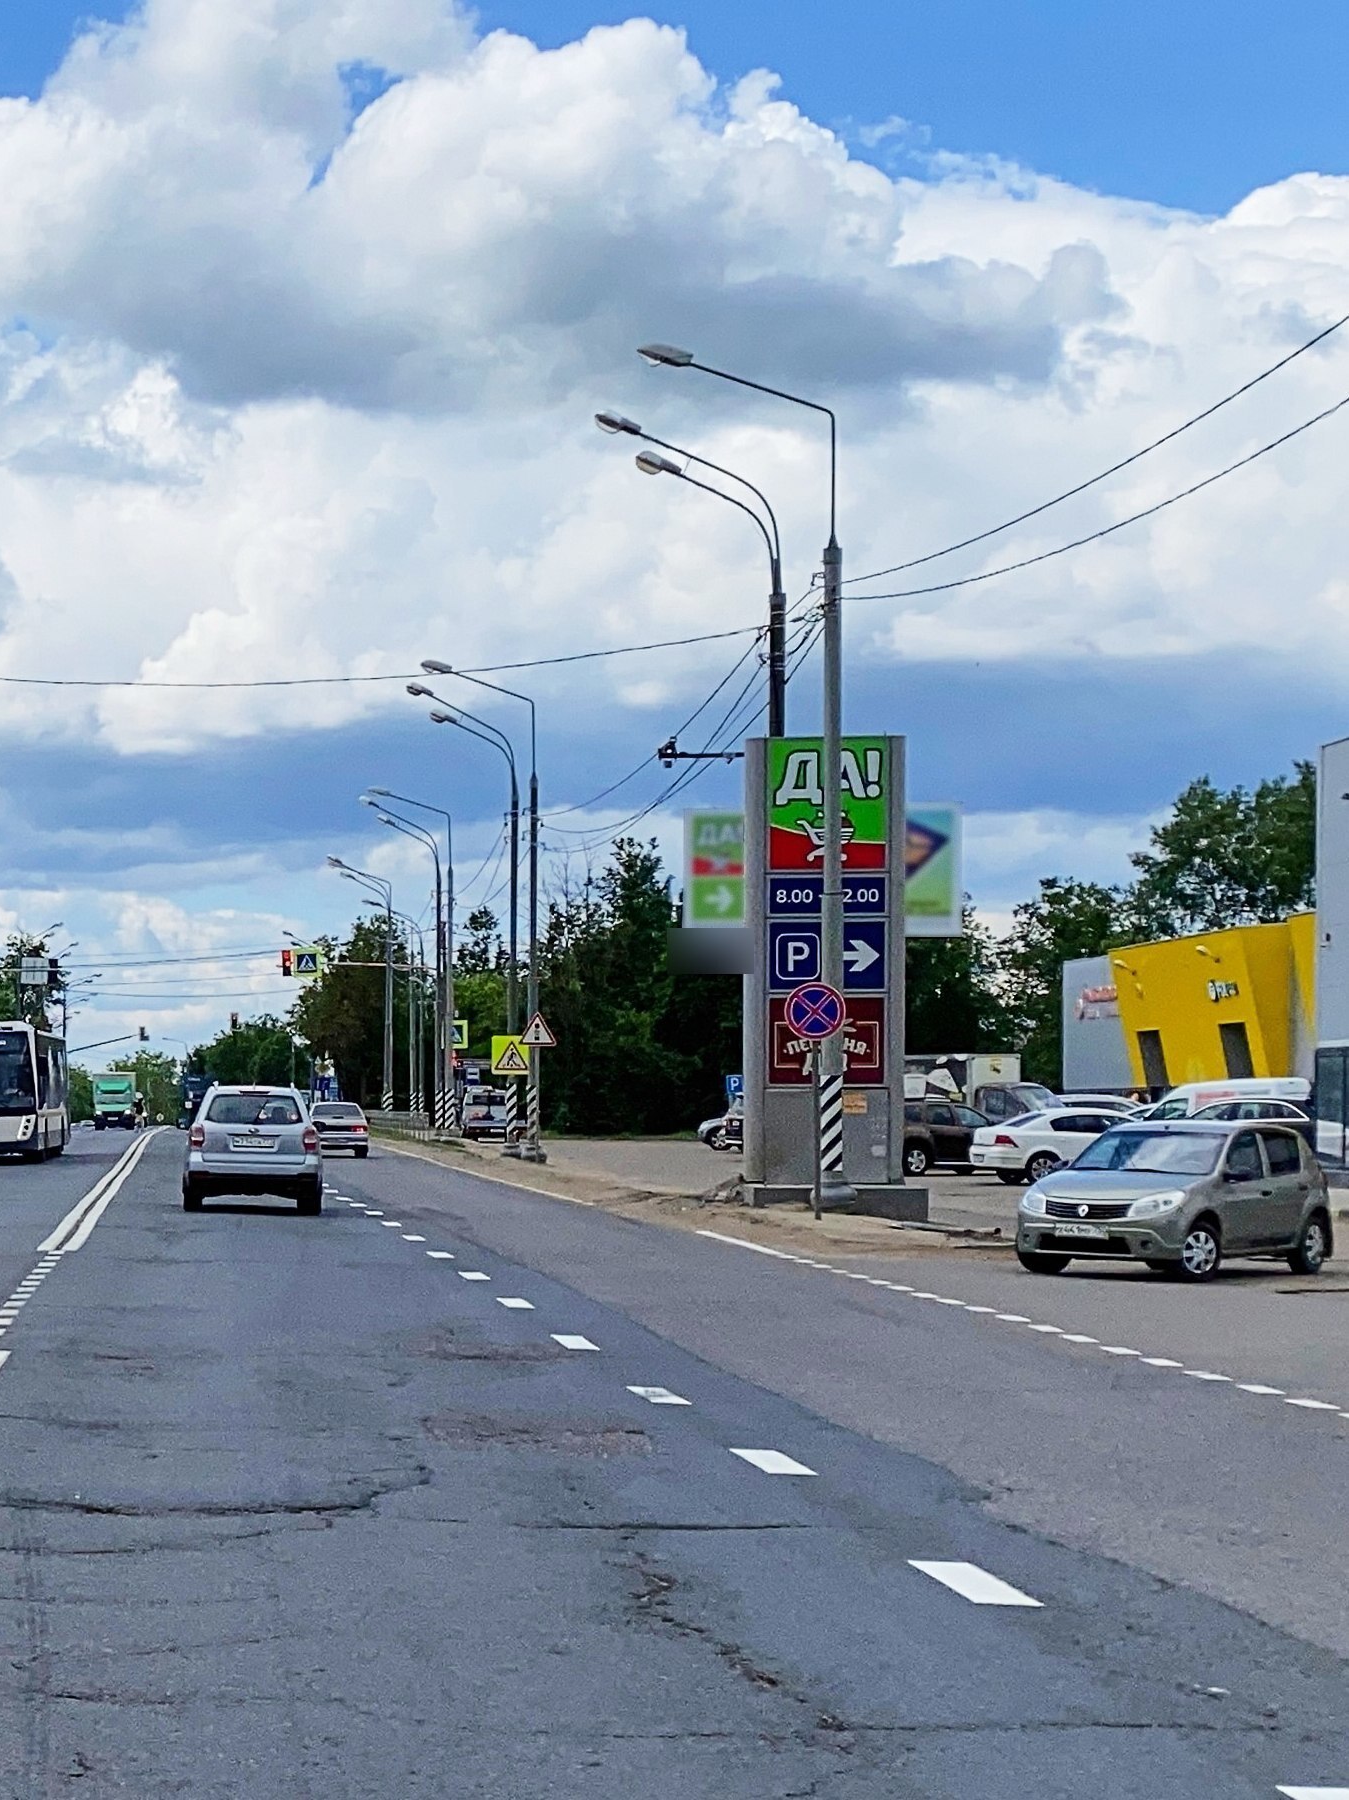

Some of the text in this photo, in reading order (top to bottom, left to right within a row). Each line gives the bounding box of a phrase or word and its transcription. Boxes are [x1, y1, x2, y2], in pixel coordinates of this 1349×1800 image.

[776, 888, 880, 904] 8.00 2.00
[787, 941, 810, 972] P
[786, 1037, 867, 1056] ПЕНЯ
